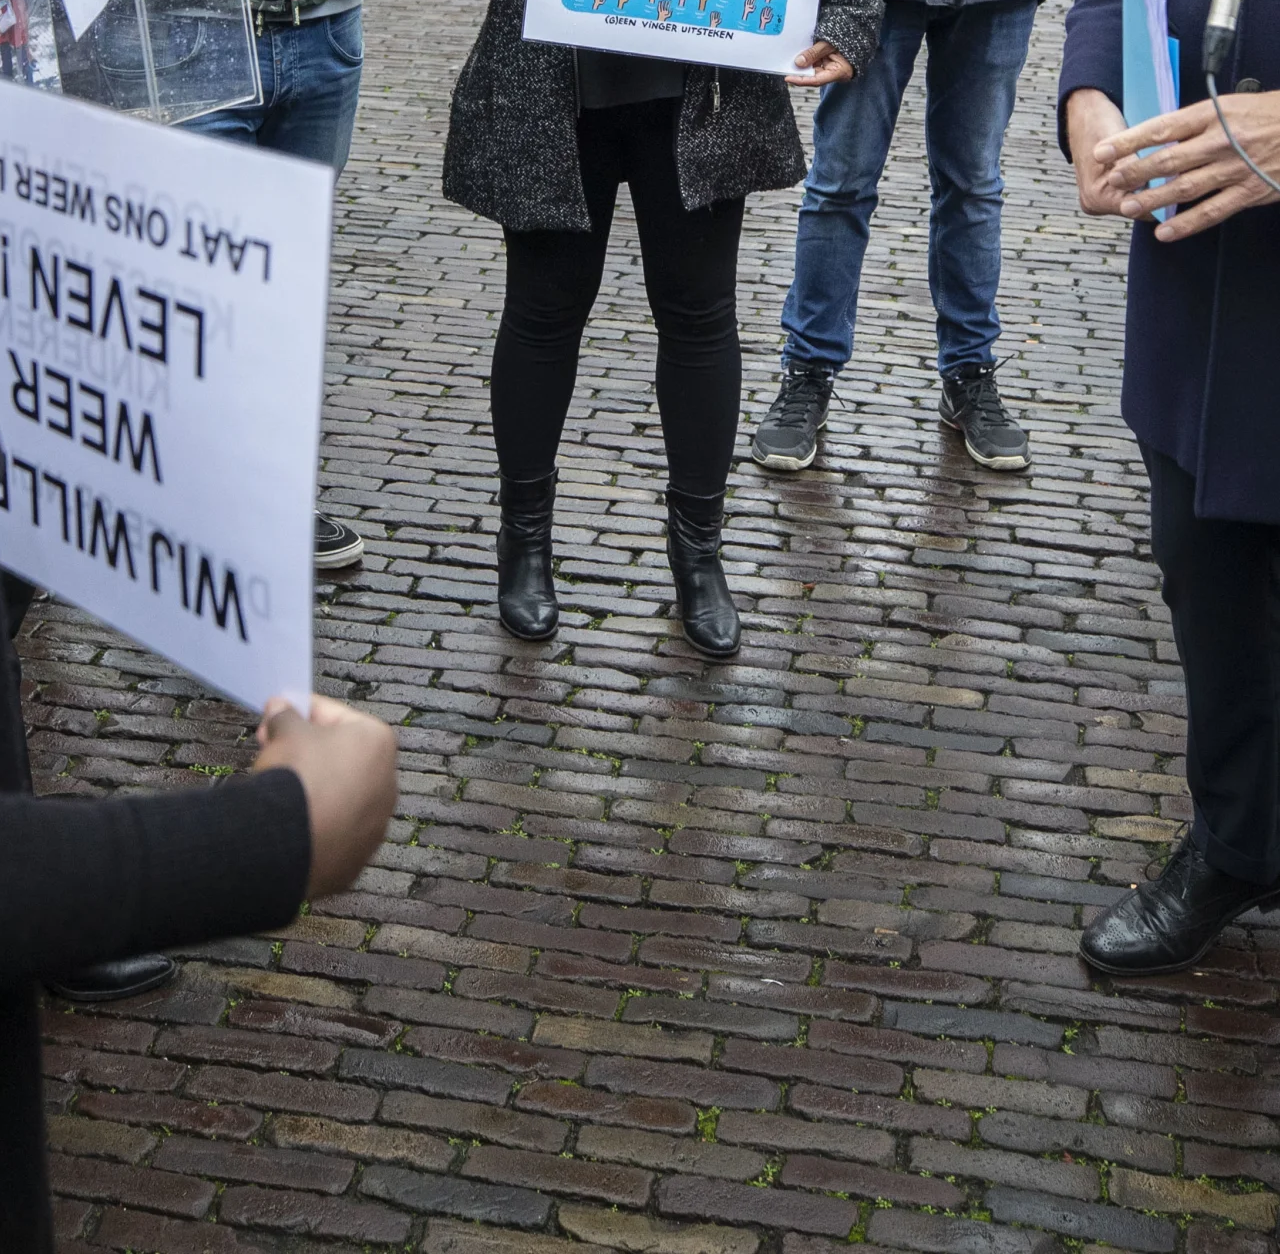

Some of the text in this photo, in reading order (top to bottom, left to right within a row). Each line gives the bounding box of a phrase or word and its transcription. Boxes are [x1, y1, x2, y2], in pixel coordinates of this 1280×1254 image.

[604, 14, 637, 27] (G)EEN
[681, 26, 735, 40] UITSTEKEN
[14, 163, 93, 220] WEER
[105, 195, 168, 248] ONS
[181, 220, 271, 281] LAAT
[30, 246, 205, 379] LEVEN
[6, 349, 163, 484] WEER
[149, 529, 249, 643] WIJ
